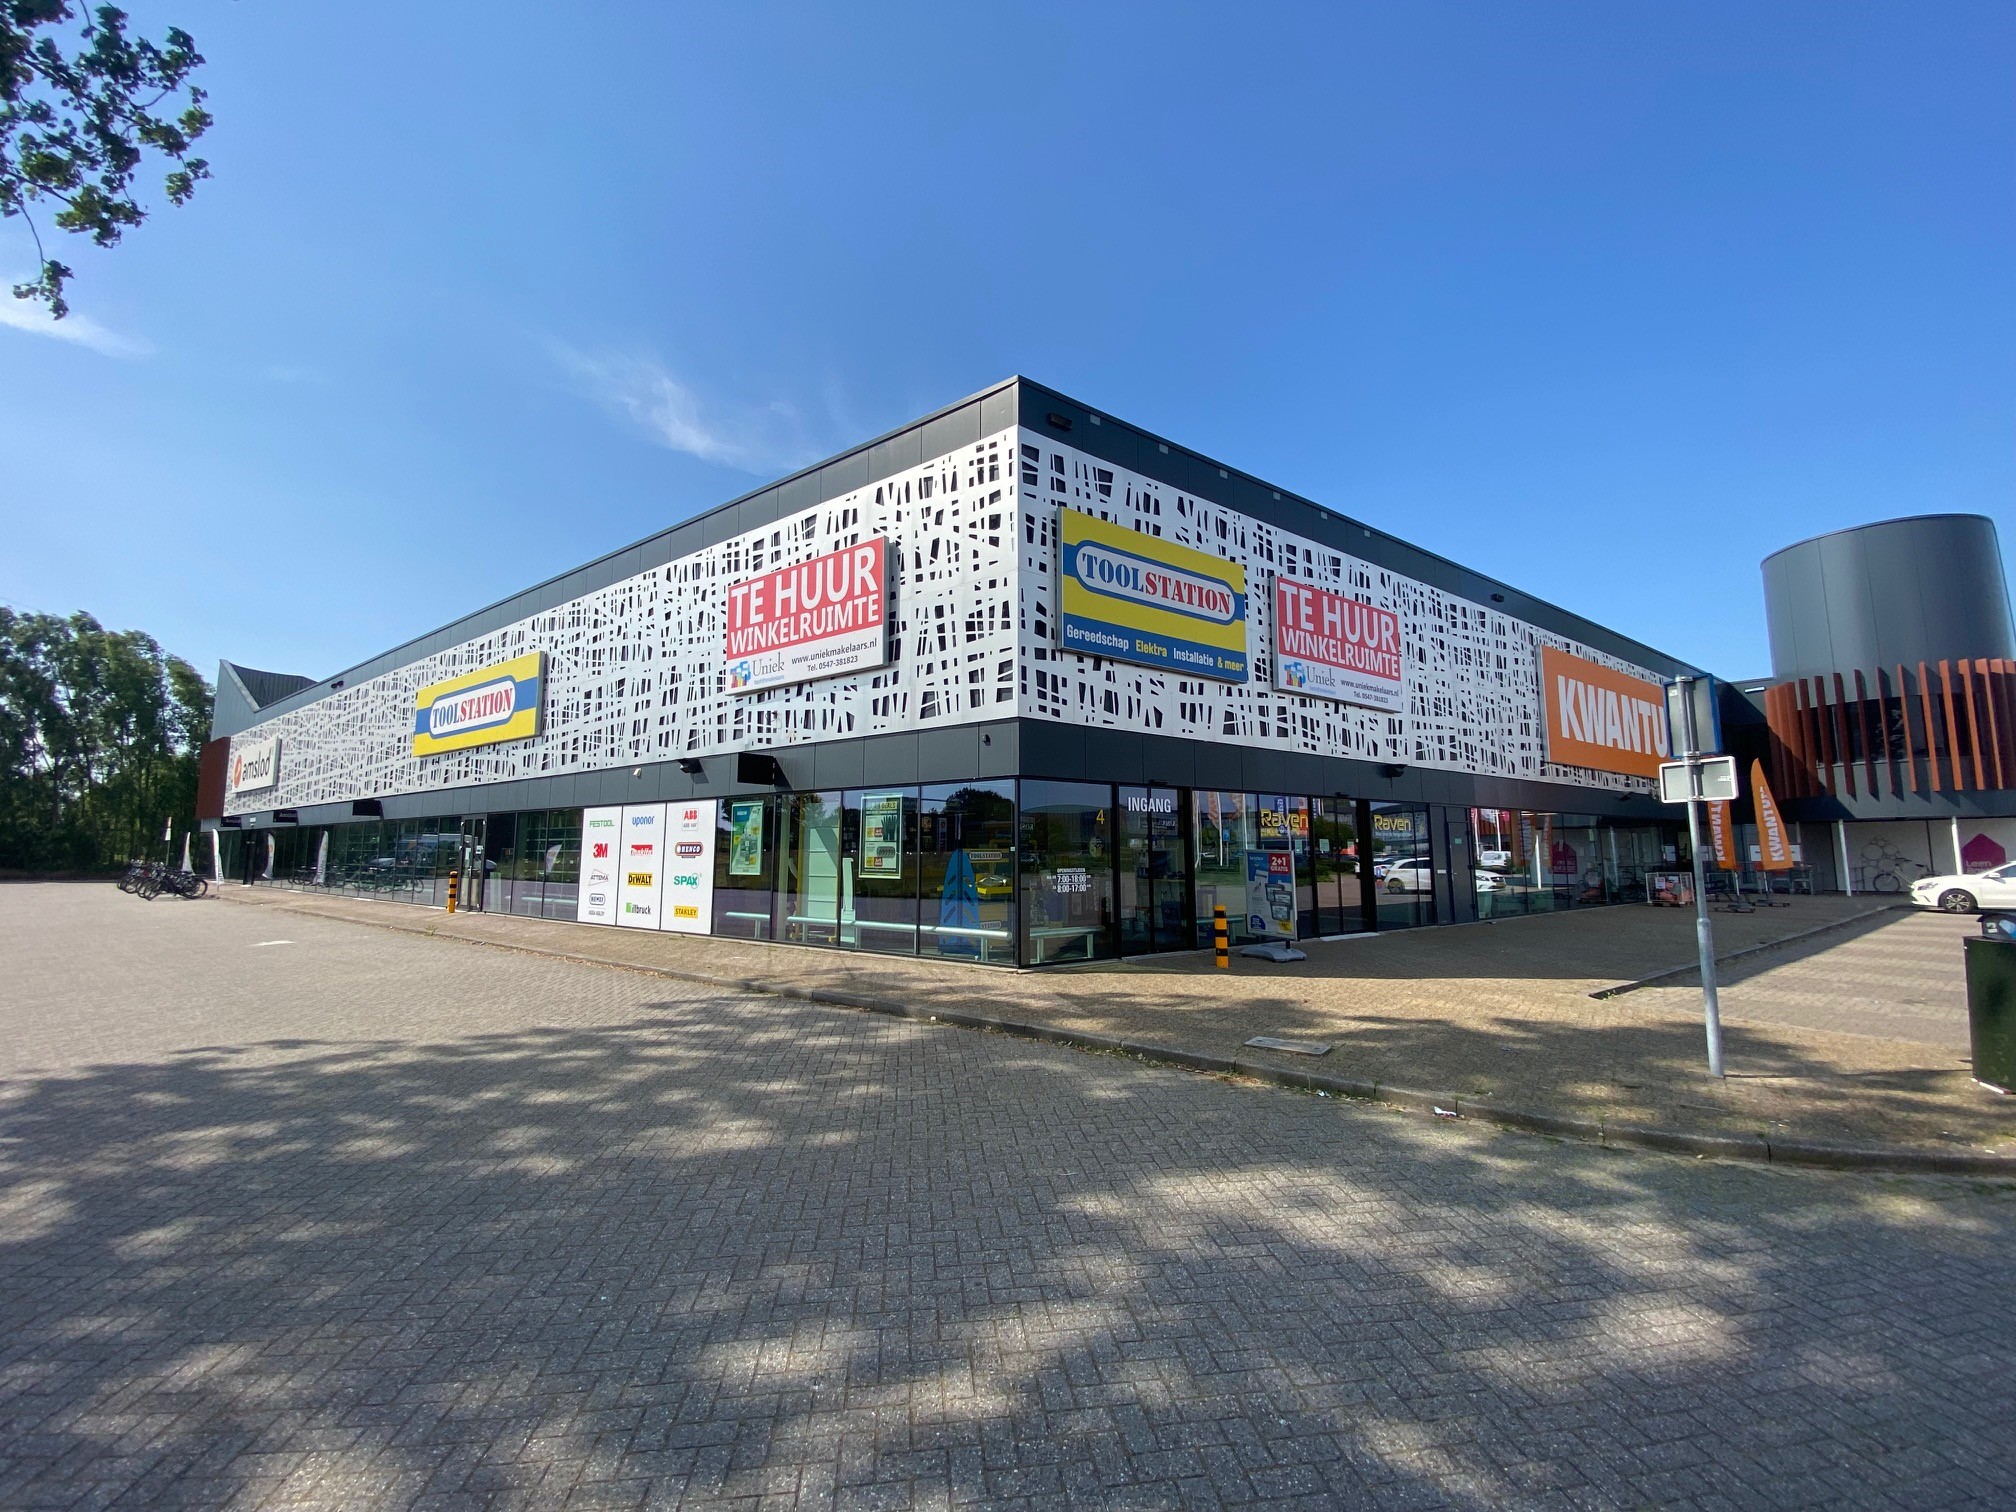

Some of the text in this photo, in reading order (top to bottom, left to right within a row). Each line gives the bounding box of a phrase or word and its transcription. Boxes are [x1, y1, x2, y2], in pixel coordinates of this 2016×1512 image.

[731, 546, 878, 628] TE HUUR
[1083, 553, 1231, 614] TOOLSTATION
[731, 593, 879, 655] WINKELRUIMTE
[1280, 582, 1396, 653] TE HUUR
[792, 638, 877, 665] www.uniekmakelaars.nl
[1067, 624, 1244, 672] Gereedschap Elektra Installatie & meer
[1282, 626, 1398, 677] WINKELRUIMTE
[752, 652, 784, 677] Uniek
[807, 656, 858, 672] Tel. 0547-381823
[1306, 665, 1336, 688] Uniek
[432, 688, 513, 729] TOOLSTATION
[1557, 674, 1668, 758] KWANTU
[242, 747, 272, 781] amslod
[684, 809, 697, 820] ABB
[1128, 797, 1171, 813] INGANG
[589, 819, 614, 828] FESTOOL
[632, 816, 654, 827] uponor
[1096, 809, 1105, 825] 4
[1261, 809, 1309, 828] Raven
[1373, 814, 1410, 831] Raven
[1711, 800, 1726, 861] KWANT
[593, 843, 608, 858] 3M
[681, 845, 701, 853] HENCO
[1271, 856, 1286, 866] 2+1
[673, 874, 698, 887] SPAX
